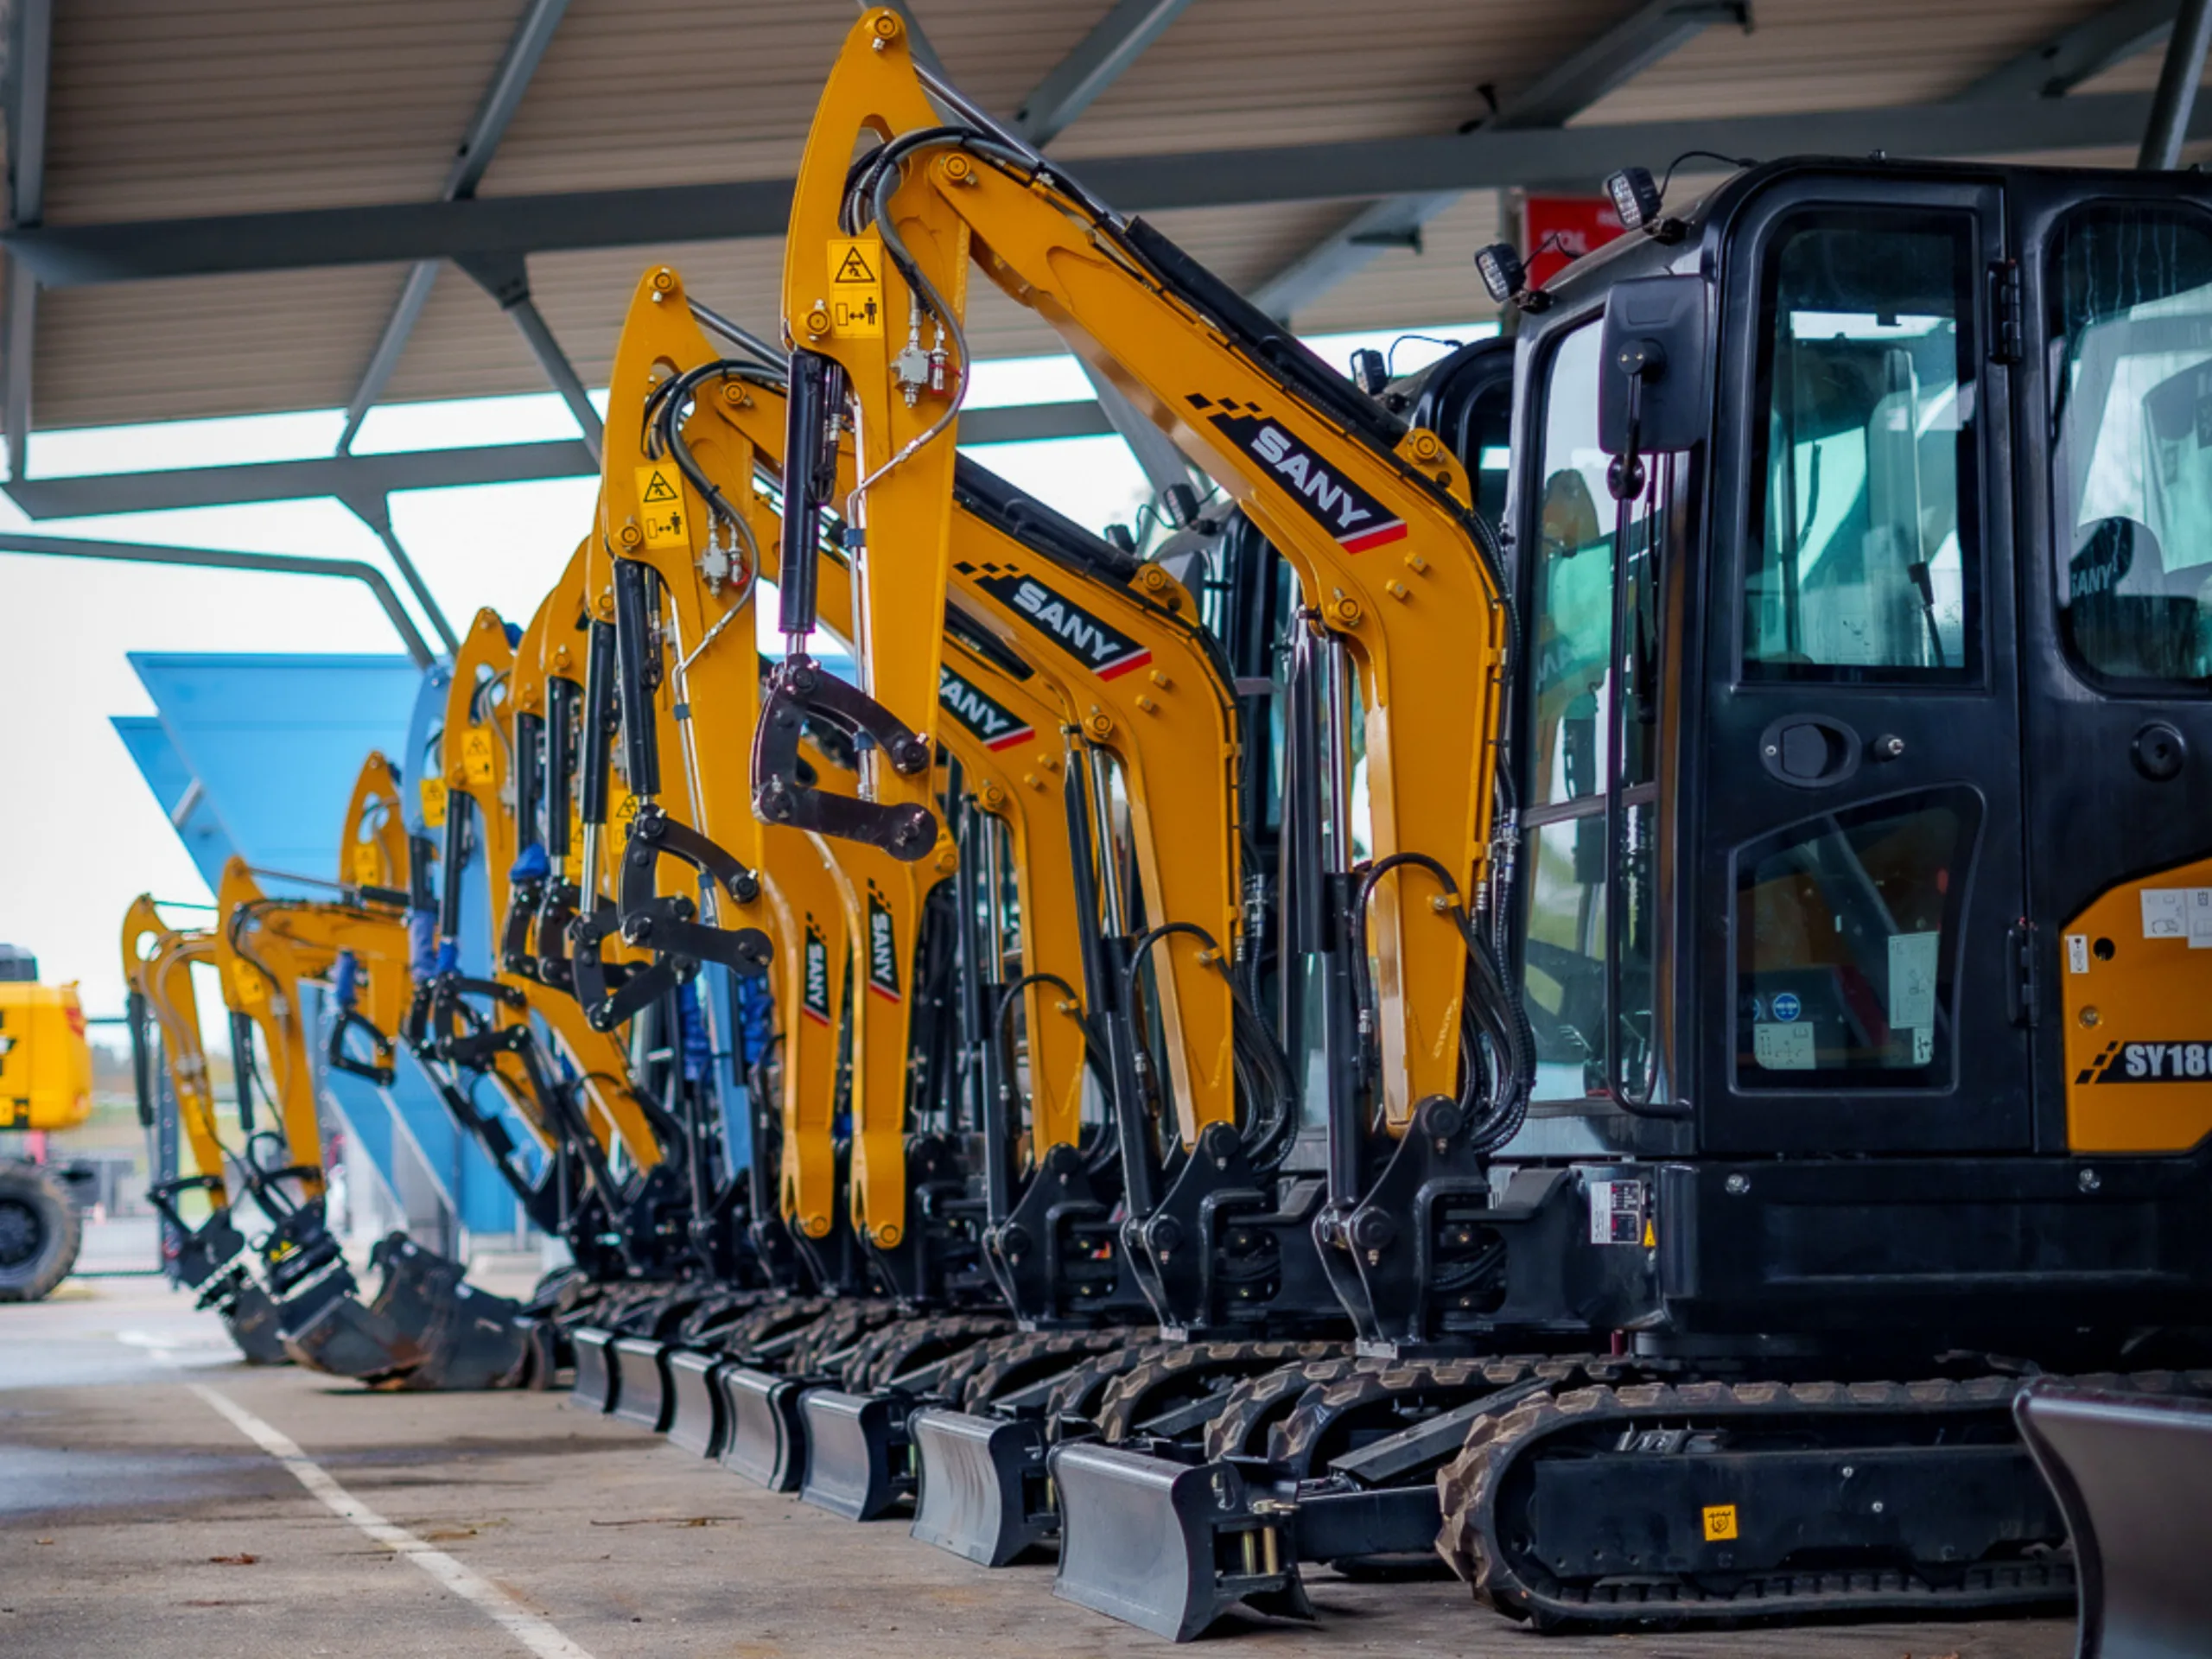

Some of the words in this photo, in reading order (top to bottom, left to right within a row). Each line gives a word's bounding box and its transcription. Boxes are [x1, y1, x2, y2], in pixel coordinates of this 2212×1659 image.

[1250, 425, 1372, 530] SANY
[1012, 581, 1122, 663] SANY
[808, 943, 825, 1007] SANY
[872, 912, 893, 982] SANY
[2125, 1044, 2212, 1077] SY18
